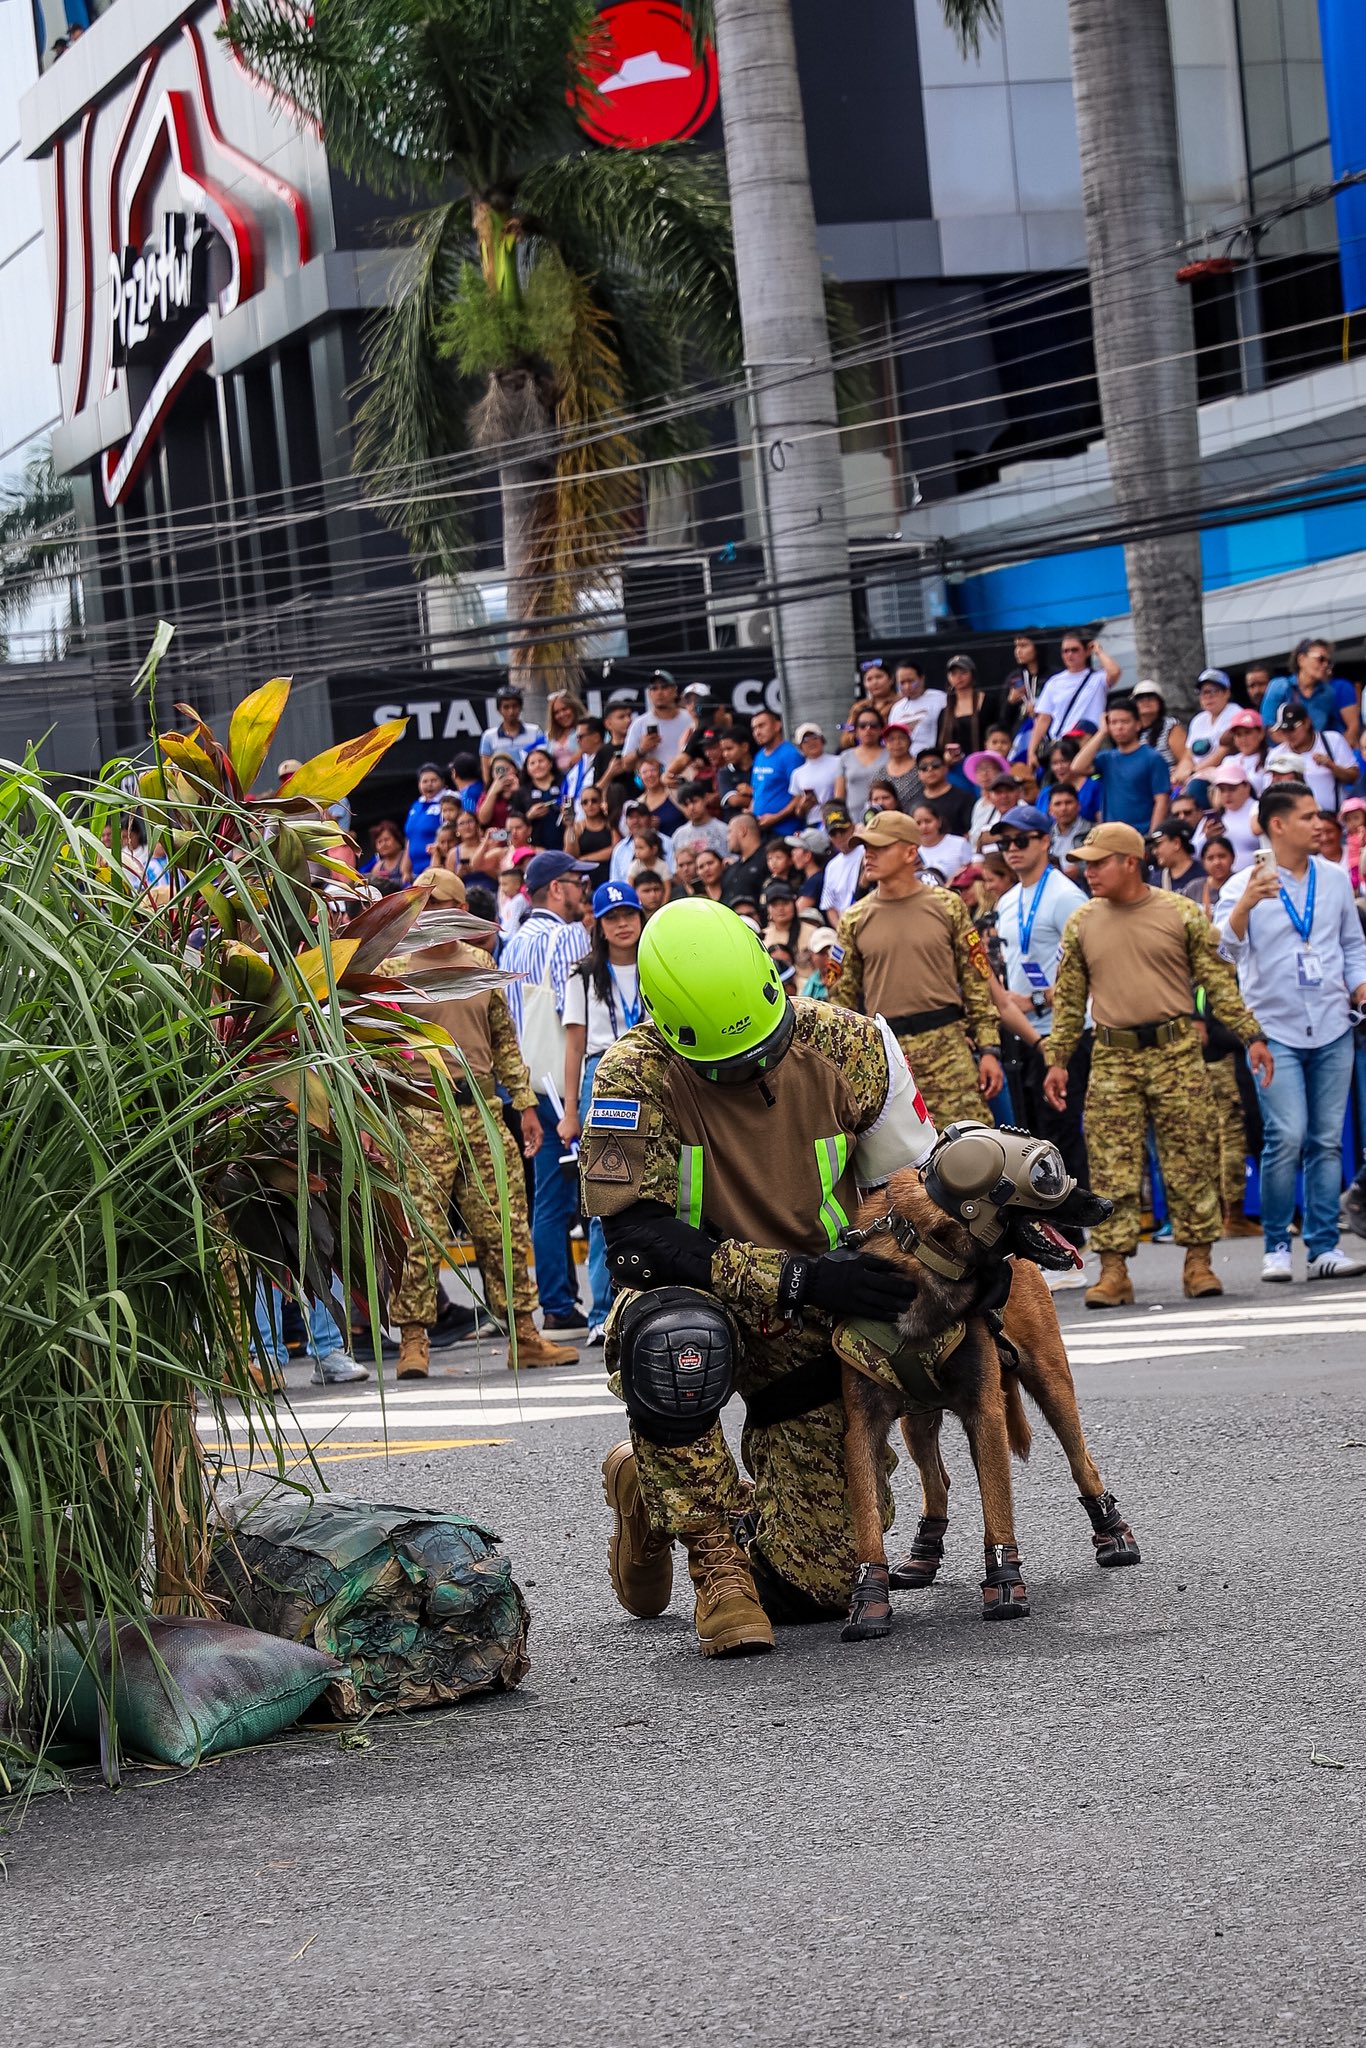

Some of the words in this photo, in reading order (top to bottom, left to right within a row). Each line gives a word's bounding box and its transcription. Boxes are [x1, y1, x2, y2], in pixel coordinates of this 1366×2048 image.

[606, 886, 623, 902] LA
[721, 1015, 750, 1035] CAMP
[592, 1109, 600, 1117] EL
[601, 1110, 637, 1119] SALVADOR
